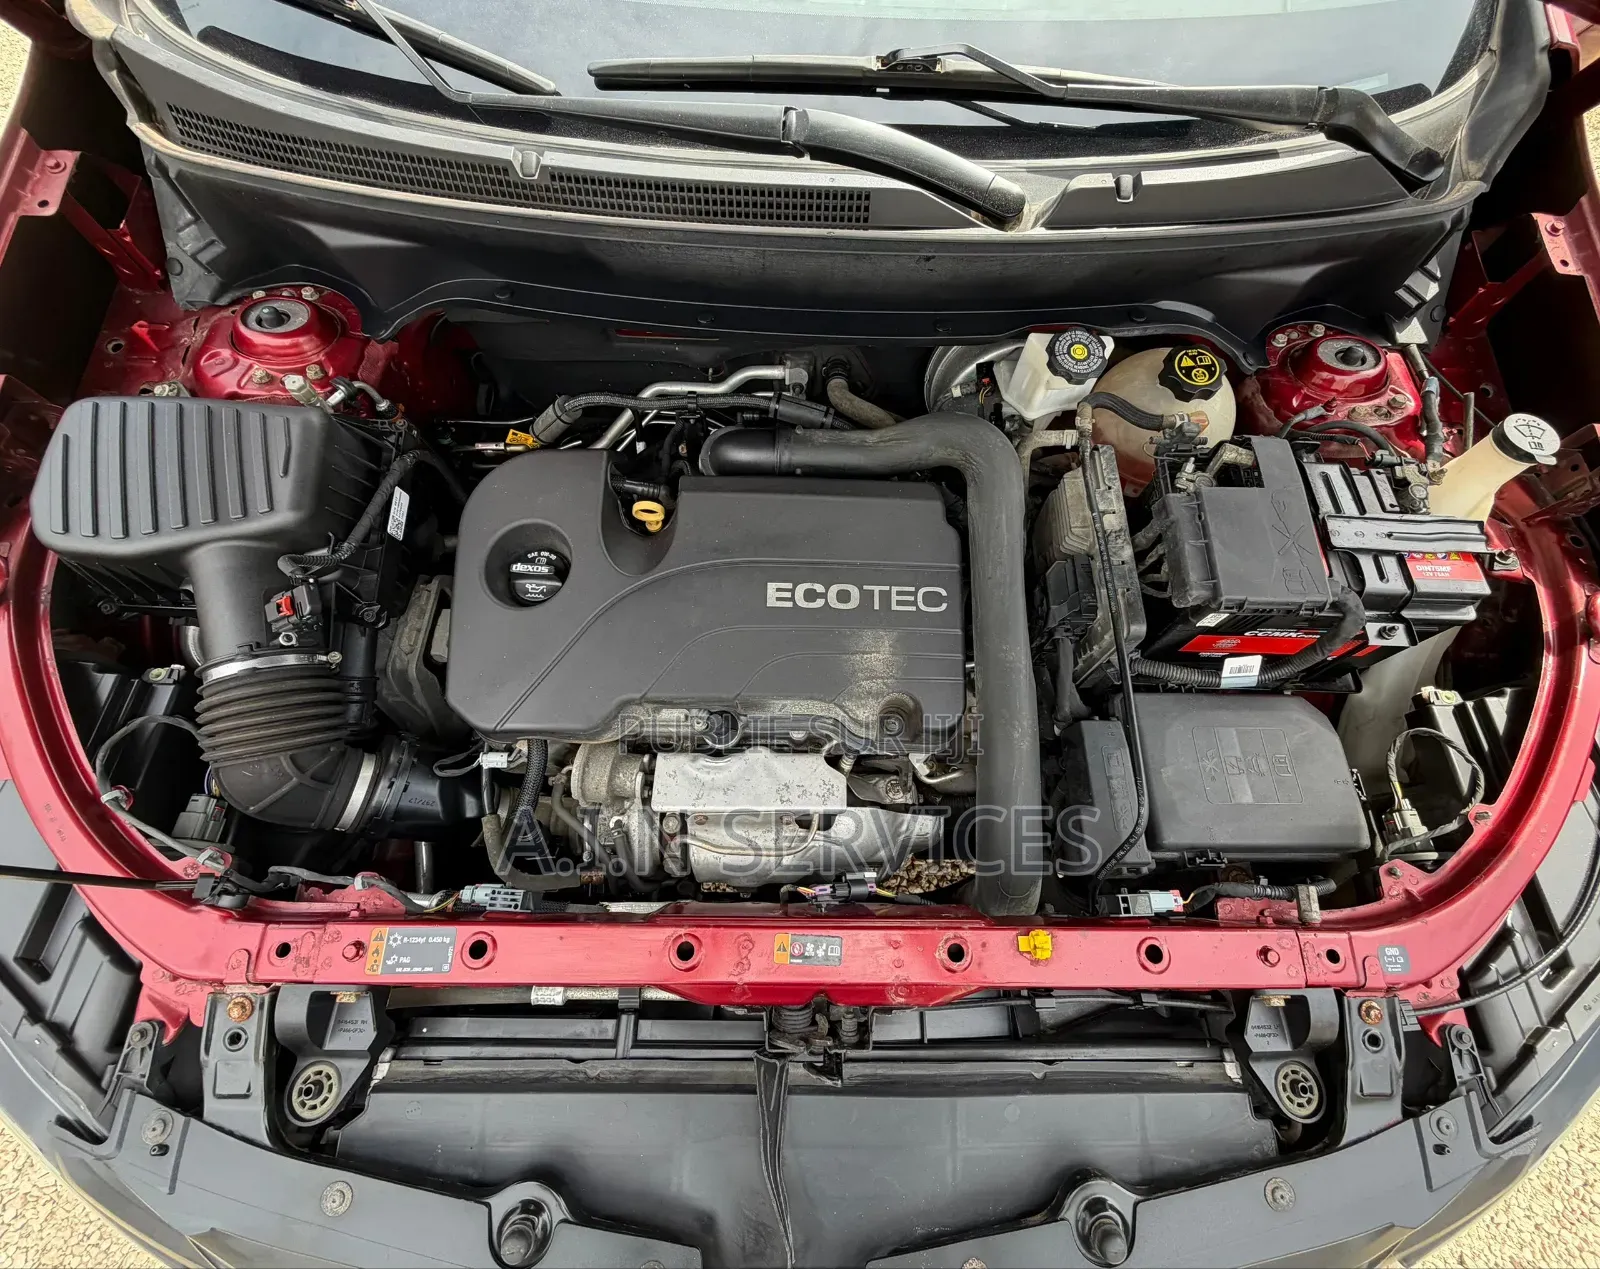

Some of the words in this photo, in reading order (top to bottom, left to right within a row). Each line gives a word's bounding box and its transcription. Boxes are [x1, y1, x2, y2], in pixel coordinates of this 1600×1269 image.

[512, 562, 549, 573] dexos
[766, 582, 948, 613] ECOTEC
[403, 936, 426, 944] R-1234yf
[443, 936, 450, 944] kg
[1385, 947, 1399, 955] GND
